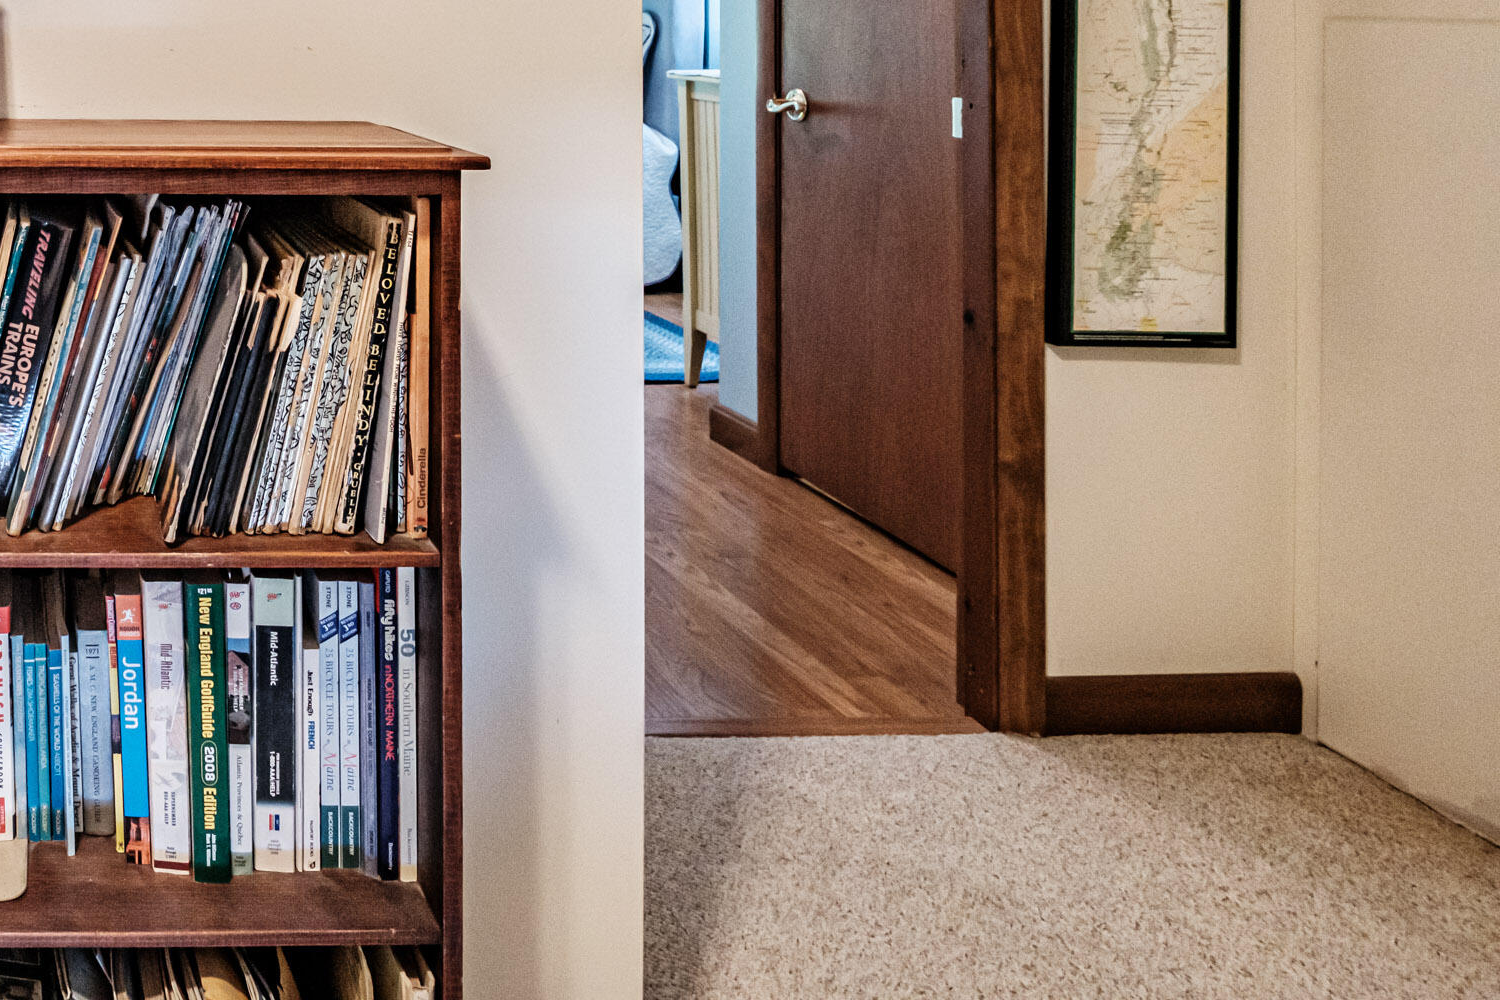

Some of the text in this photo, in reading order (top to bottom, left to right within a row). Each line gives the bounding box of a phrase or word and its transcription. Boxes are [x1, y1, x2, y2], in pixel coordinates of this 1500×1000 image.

[21, 231, 52, 320] TRAVELING
[373, 233, 399, 335] BELOVED
[8, 322, 40, 408] EUROPE'S
[355, 344, 380, 446] BELINDY
[416, 447, 427, 509] Cinderella
[198, 597, 212, 625] New
[380, 598, 396, 625] fifty
[159, 643, 173, 690] Mid-Atlantic
[198, 627, 214, 677] England
[269, 631, 280, 687] Mid-Atlantic
[384, 625, 396, 661] hikes
[52, 673, 61, 705] SEASHELLS
[69, 656, 77, 681] Great
[122, 657, 142, 730] Jordan
[200, 679, 215, 739] GolfGuide
[307, 688, 315, 717] Enough
[384, 673, 395, 726] NORTHERN
[400, 628, 416, 776] 50 in Southern Maine
[53, 728, 61, 751] WORLD
[71, 725, 79, 754] Acadia
[308, 720, 316, 750] FRENCH
[323, 648, 337, 791] 25 BICYCLE TOURS Maine
[343, 648, 357, 792] 25 BICYCLE TOURS Maine
[90, 694, 101, 823] NEW ENGLAND CANOEING GUIDE
[203, 746, 216, 782] 2008
[384, 729, 396, 761] MAINE
[72, 768, 81, 798] Mount
[73, 800, 82, 828] Desert
[203, 787, 218, 830] Edition
